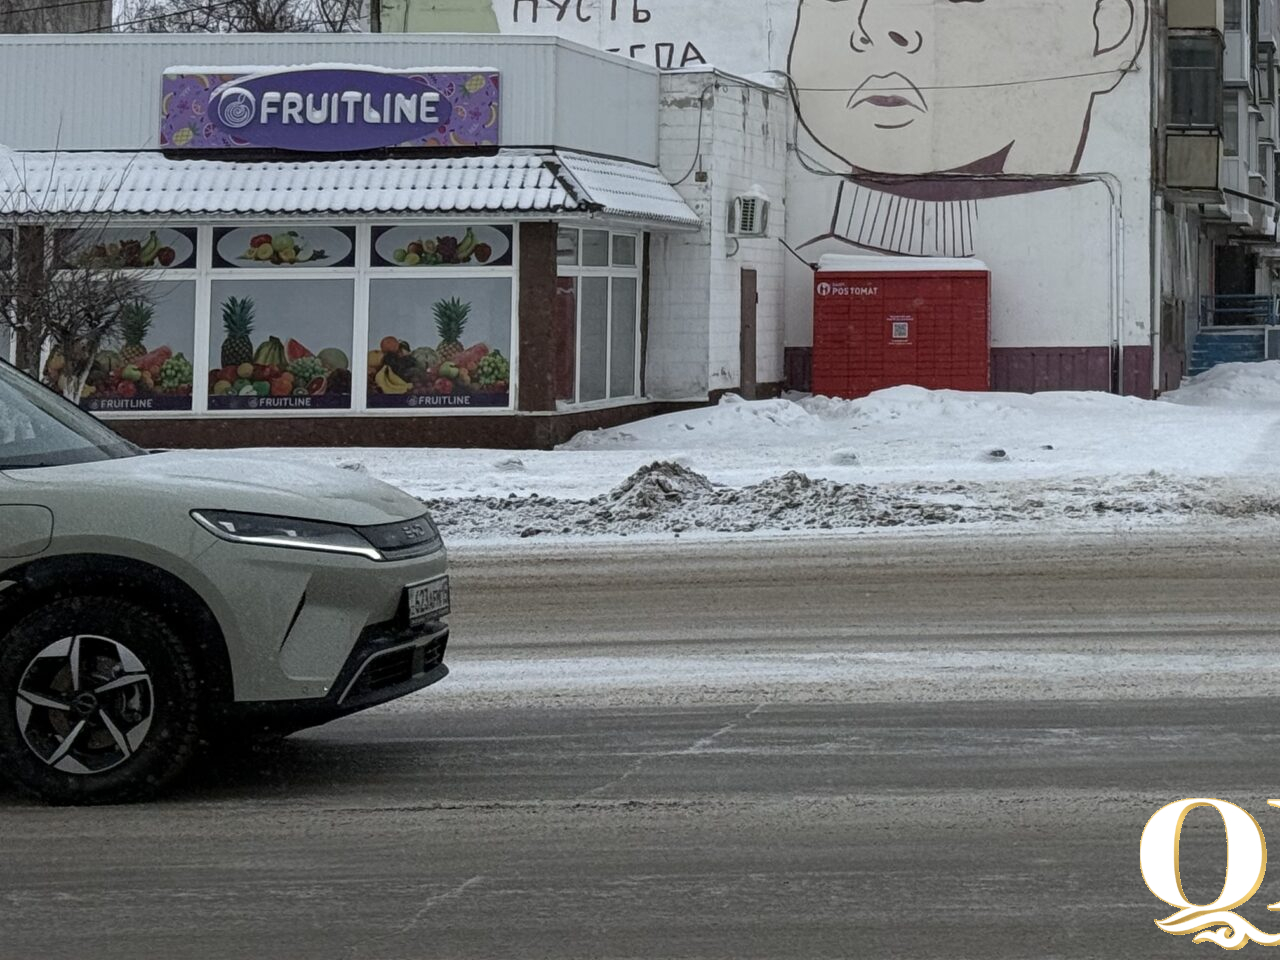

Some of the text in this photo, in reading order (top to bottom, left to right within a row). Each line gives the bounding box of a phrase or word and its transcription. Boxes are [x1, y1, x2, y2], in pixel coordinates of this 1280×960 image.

[260, 92, 439, 124] FRUITLINE
[832, 287, 878, 296] POSTOMAT
[101, 398, 152, 409] FRUITLINE
[259, 397, 311, 407] FRUITLINE
[418, 395, 470, 405] FRUITLINE
